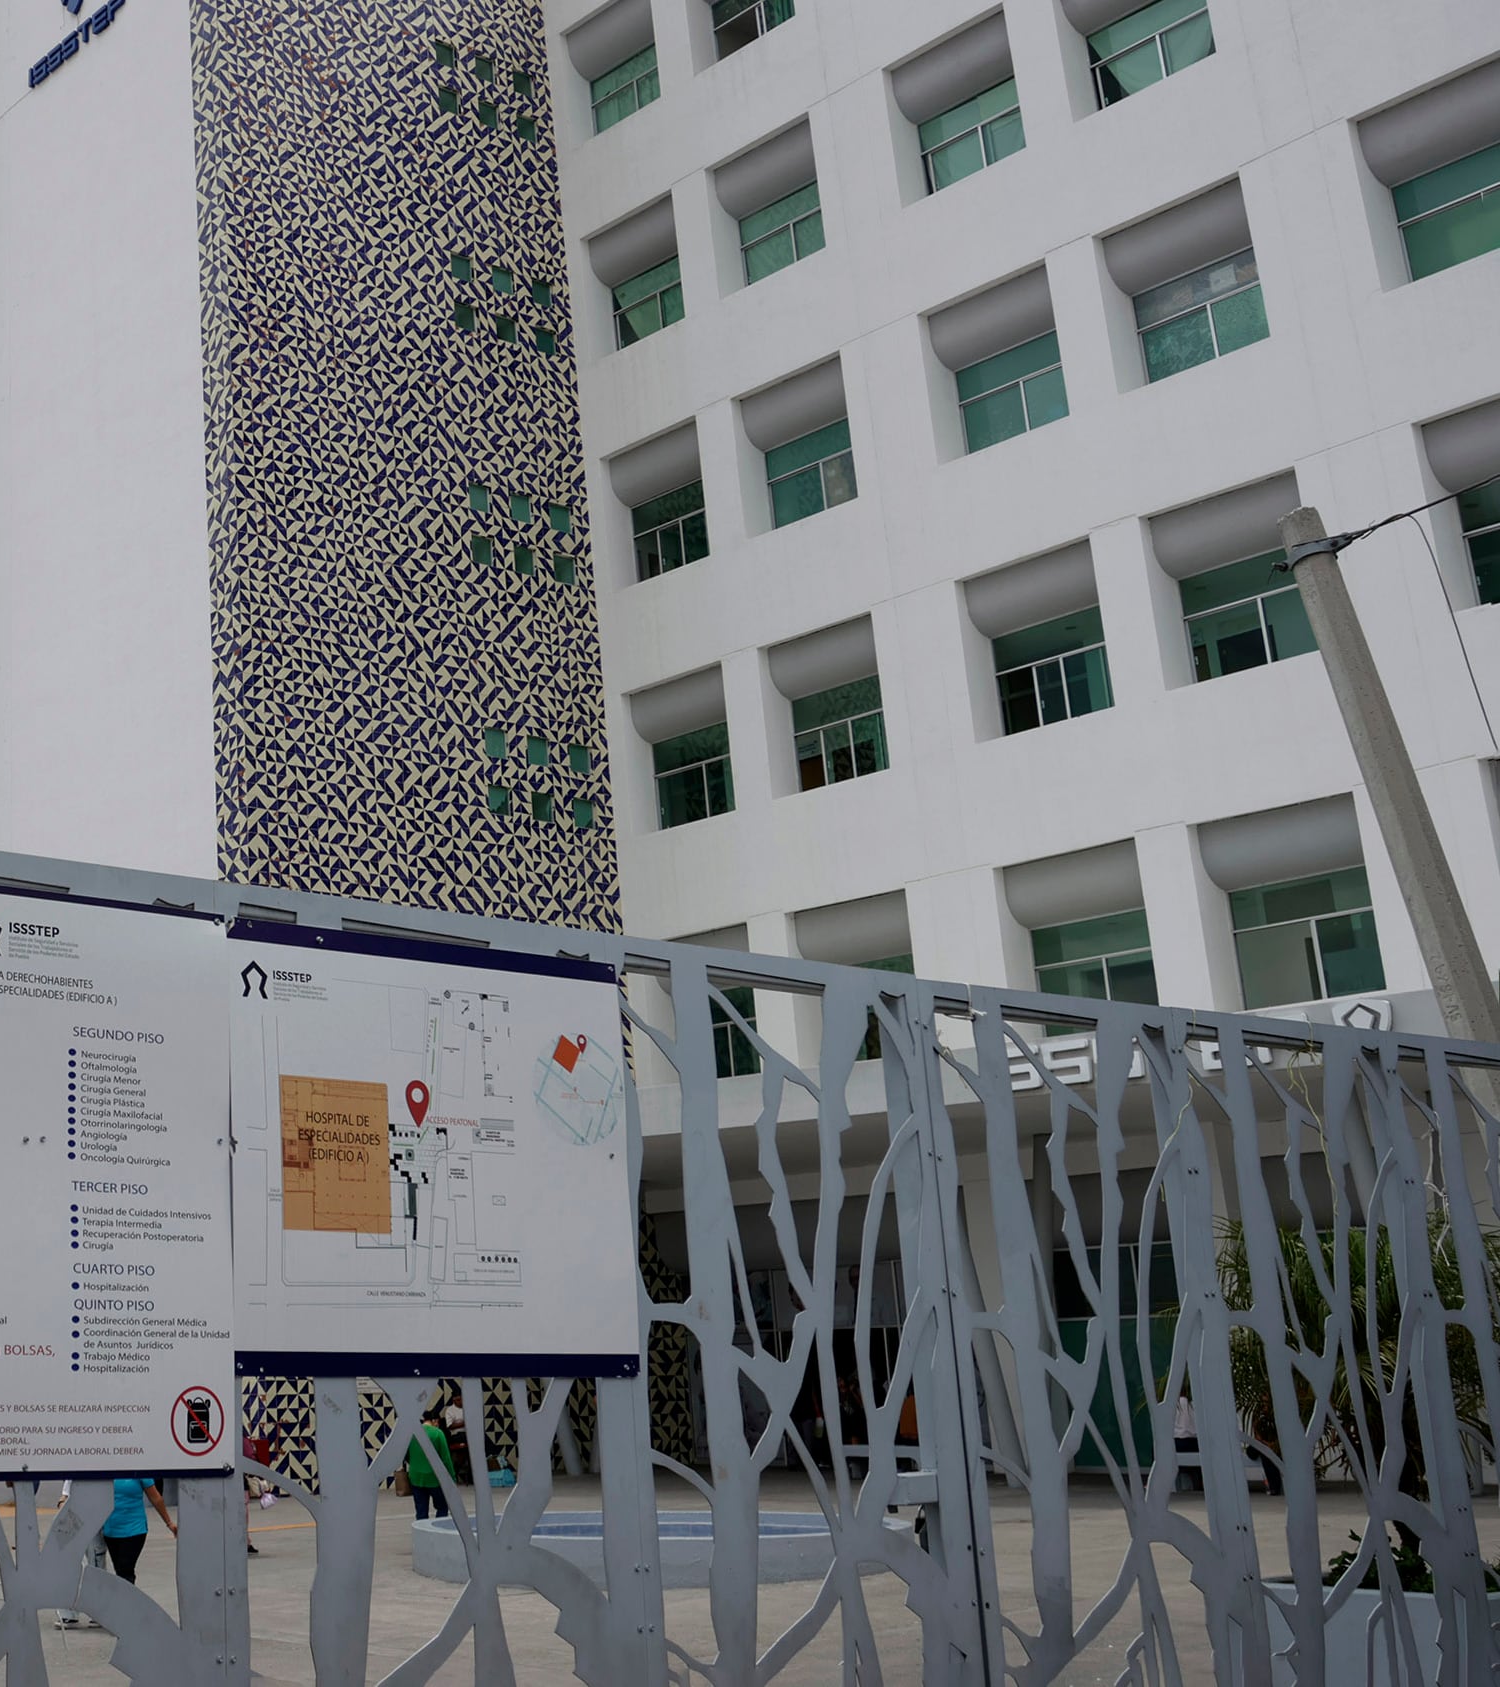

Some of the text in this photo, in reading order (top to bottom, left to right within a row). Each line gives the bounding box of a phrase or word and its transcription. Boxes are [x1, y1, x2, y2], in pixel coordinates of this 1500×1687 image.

[28, 0, 126, 88] ISSSTEP
[9, 922, 59, 937] ISSSTEP
[6, 971, 93, 989] DERECHOHABIENTES
[272, 970, 312, 983] ISSSTEP
[66, 991, 105, 1004] (EDIFICIO
[72, 1026, 164, 1044] SEGUNDO PISO
[80, 1050, 136, 1063] Neurocirugía
[80, 1061, 137, 1074] Oftalmología
[80, 1073, 141, 1085] Cirugía Menor
[80, 1084, 146, 1097] Cirugía General
[80, 1095, 145, 1108] Cirugía Plástica
[80, 1107, 162, 1120] Cirugía Maxilofacial
[305, 1111, 369, 1127] HOSPITAL DE
[80, 1118, 167, 1132] Otorrinolaringología
[426, 1116, 479, 1127] ACCESO PEATONAL
[80, 1130, 127, 1142] Angiología
[298, 1128, 380, 1145] ESPECIALIDADES
[80, 1141, 117, 1153] Urología
[80, 1153, 171, 1167] Oncología Quirúrgica
[308, 1146, 355, 1163] (EDIFICIO
[71, 1181, 148, 1195] TERCER PISO
[82, 1206, 211, 1220] Unidad de Cuidados Intensivos
[82, 1217, 162, 1229] Terapia Intermedia
[82, 1230, 204, 1242] Recuperación Postoperatoria
[82, 1240, 114, 1252] Cirugía
[73, 1262, 155, 1276] CUARTO PISO
[83, 1282, 149, 1292] Hospitalización
[73, 1298, 154, 1311] QUINTO PISO
[83, 1315, 207, 1327] Subdirección General Médica
[83, 1327, 230, 1339] Coordinación General de la Unidad
[4, 1344, 55, 1357] BOLSAS,
[83, 1339, 173, 1350] de Asuntos Jurídicos
[83, 1351, 150, 1362] Trabajo Médico
[83, 1364, 149, 1374] Hospitalización
[6, 1404, 12, 1412] Y
[13, 1404, 45, 1412] BOLSAS
[47, 1404, 56, 1412] SE
[21, 1426, 43, 1434] PARA
[45, 1426, 56, 1434] SU
[57, 1426, 93, 1434] INGRESO
